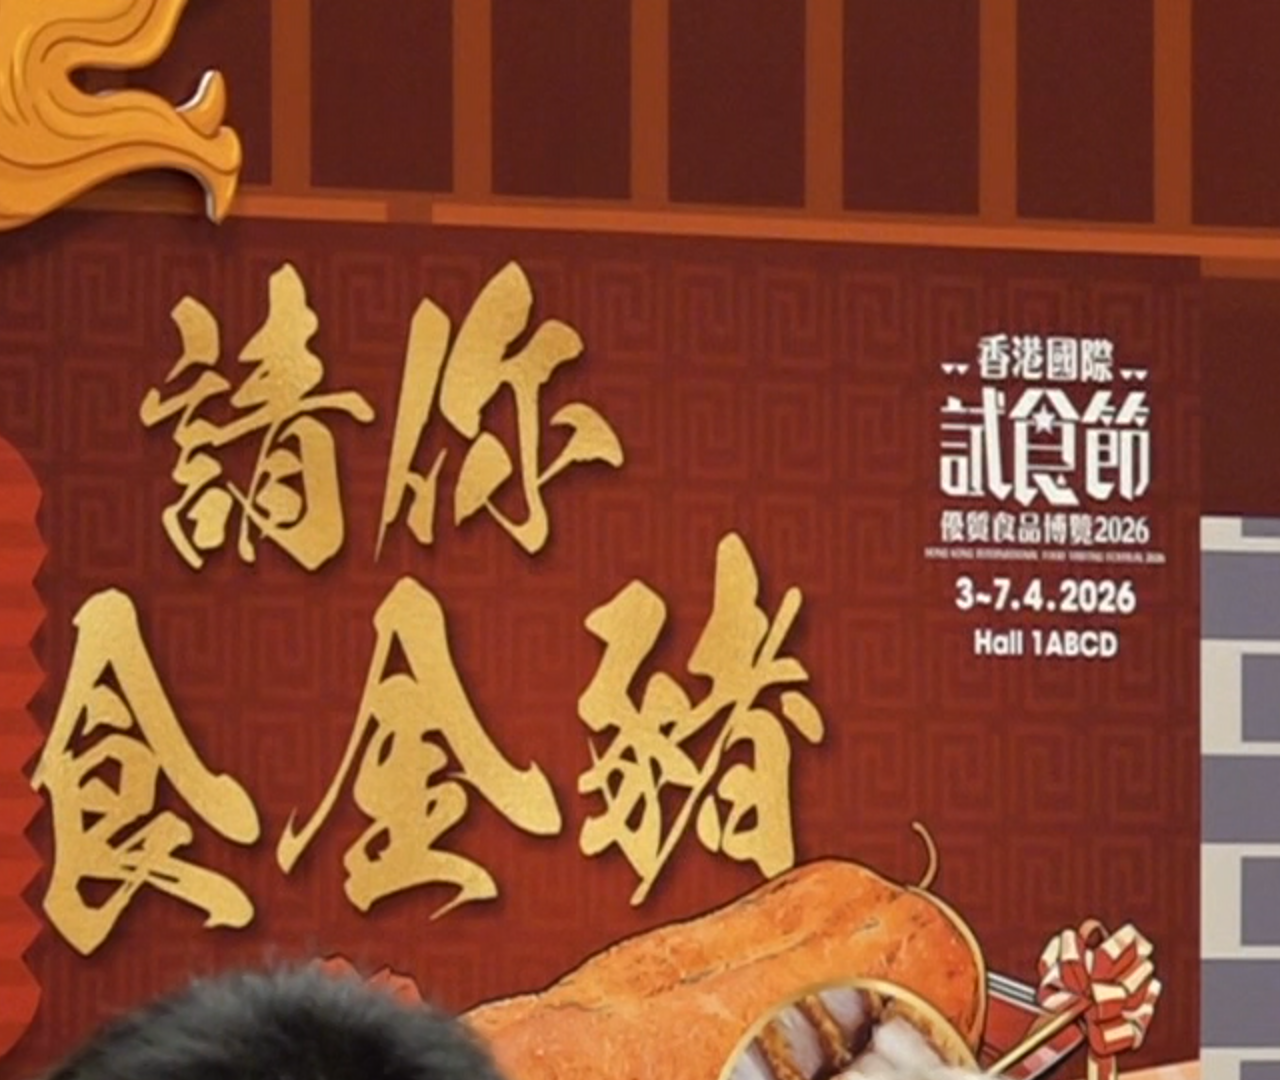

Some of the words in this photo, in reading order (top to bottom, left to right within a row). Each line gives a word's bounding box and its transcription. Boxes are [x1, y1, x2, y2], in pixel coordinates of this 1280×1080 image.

[978, 334, 1113, 382] 香港國際
[139, 262, 624, 570] 請你
[940, 386, 1150, 506] 試食節
[940, 510, 1150, 545] 優質食品博覽2026
[974, 629, 1023, 656] Hall
[1032, 631, 1118, 658] 1ABCD
[30, 532, 824, 957] 食全豬
